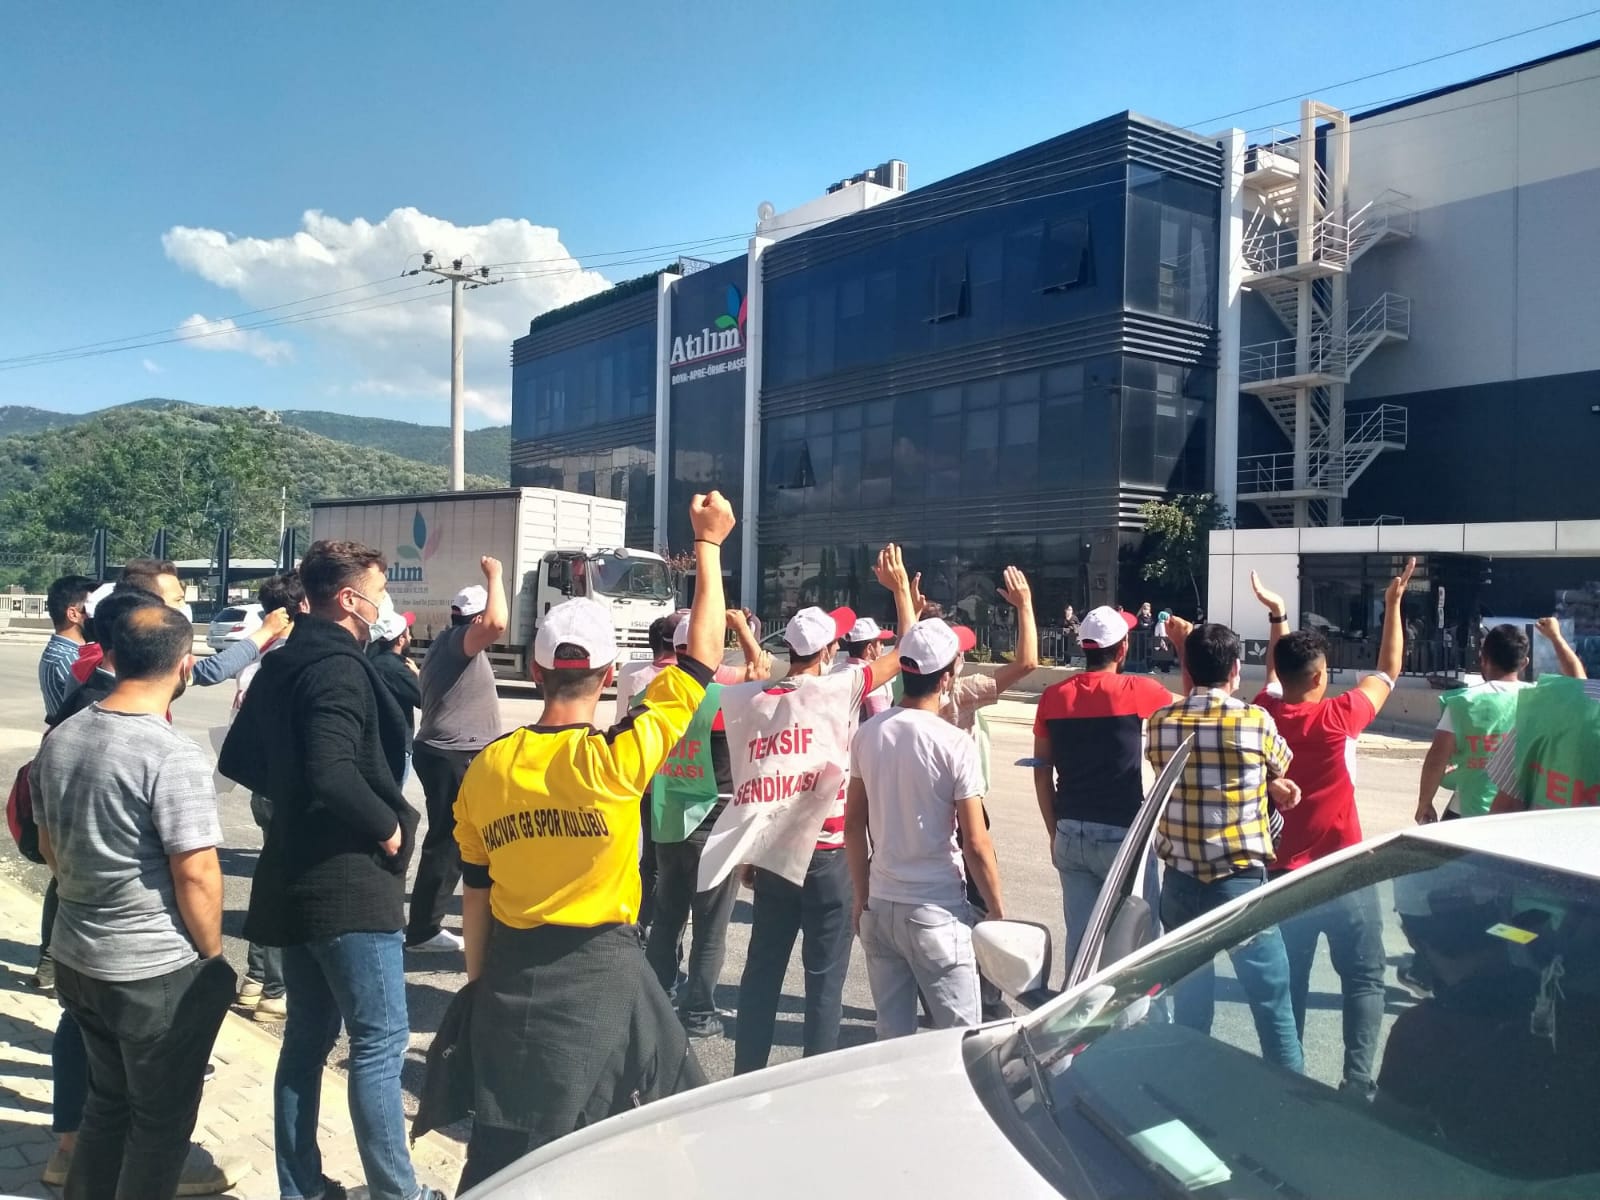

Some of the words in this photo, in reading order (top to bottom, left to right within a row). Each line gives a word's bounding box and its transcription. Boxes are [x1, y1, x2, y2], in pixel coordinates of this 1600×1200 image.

[670, 327, 741, 365] Atılım
[387, 561, 424, 582] ılım
[748, 722, 813, 763] TEKSİF
[1466, 734, 1505, 752] TE
[733, 769, 821, 807] SENDİKASI
[519, 810, 535, 839] GB
[534, 808, 563, 838] SPOR
[561, 805, 609, 838] KULÜBÜ
